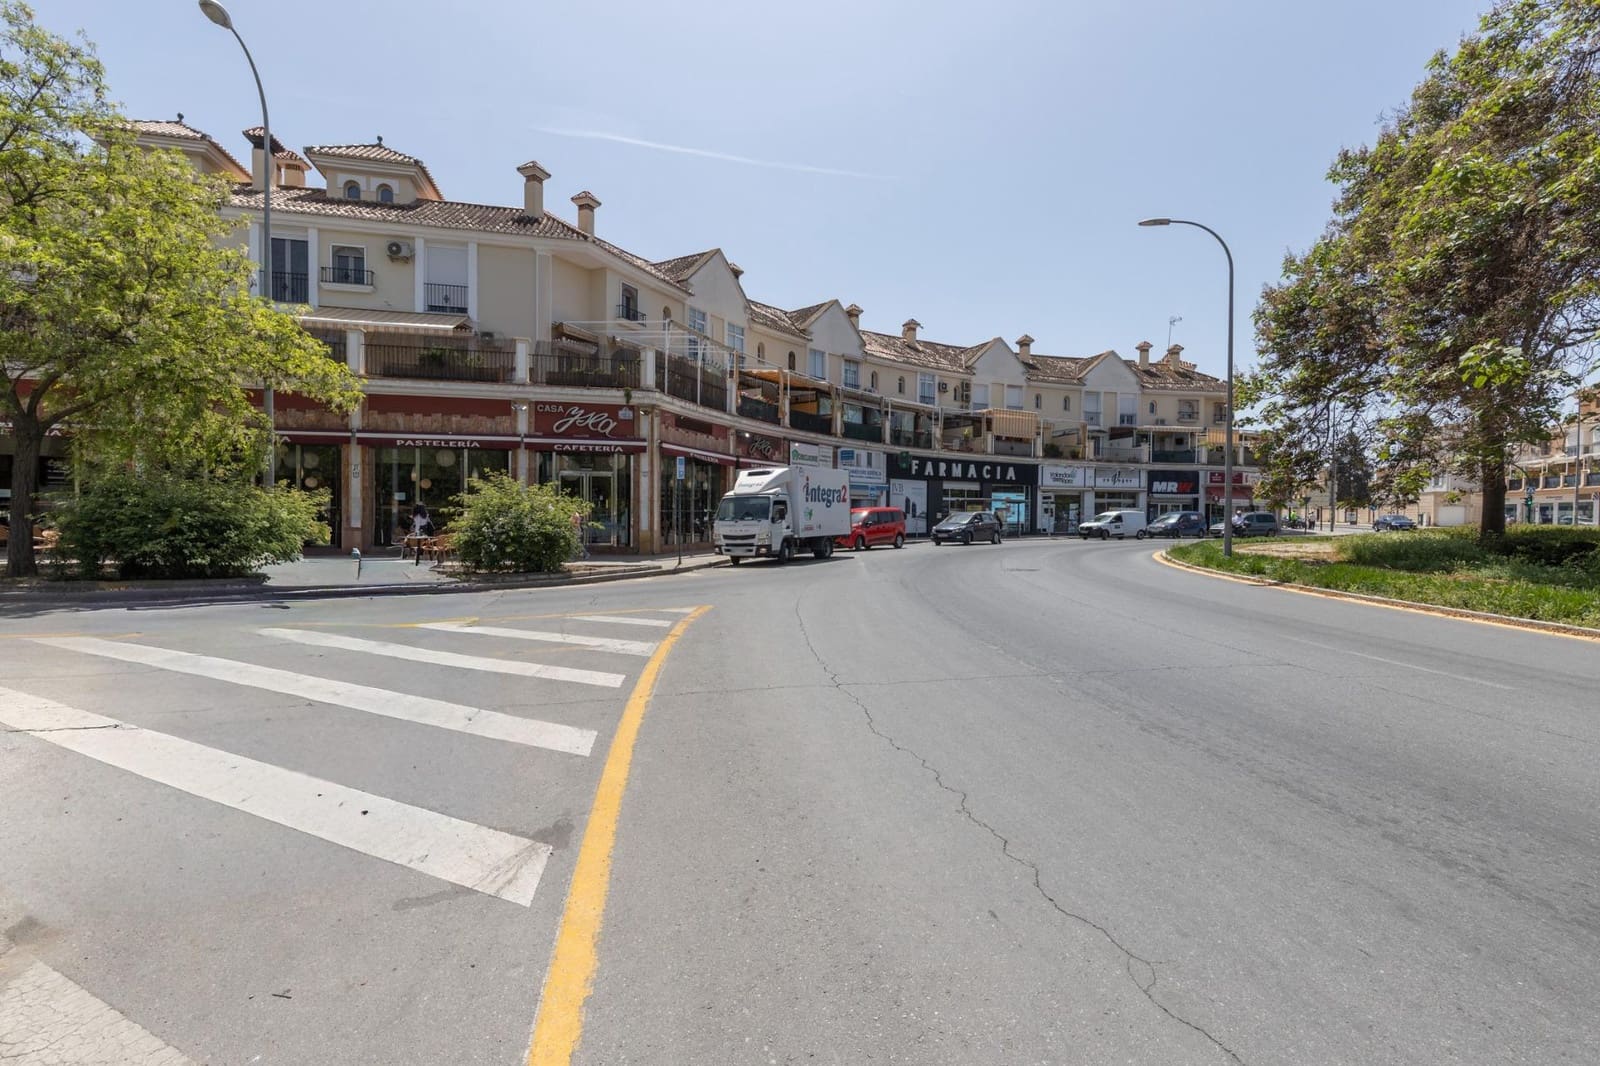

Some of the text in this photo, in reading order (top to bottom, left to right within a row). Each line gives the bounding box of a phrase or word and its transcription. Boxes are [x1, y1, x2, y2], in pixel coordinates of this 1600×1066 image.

[537, 404, 565, 413] CASA
[396, 439, 481, 448] PASTELERÍA
[554, 444, 624, 453] CAFETERÍA
[911, 459, 1016, 481] FARMACIA
[803, 476, 848, 508] integra2
[1152, 481, 1194, 493] MRW
